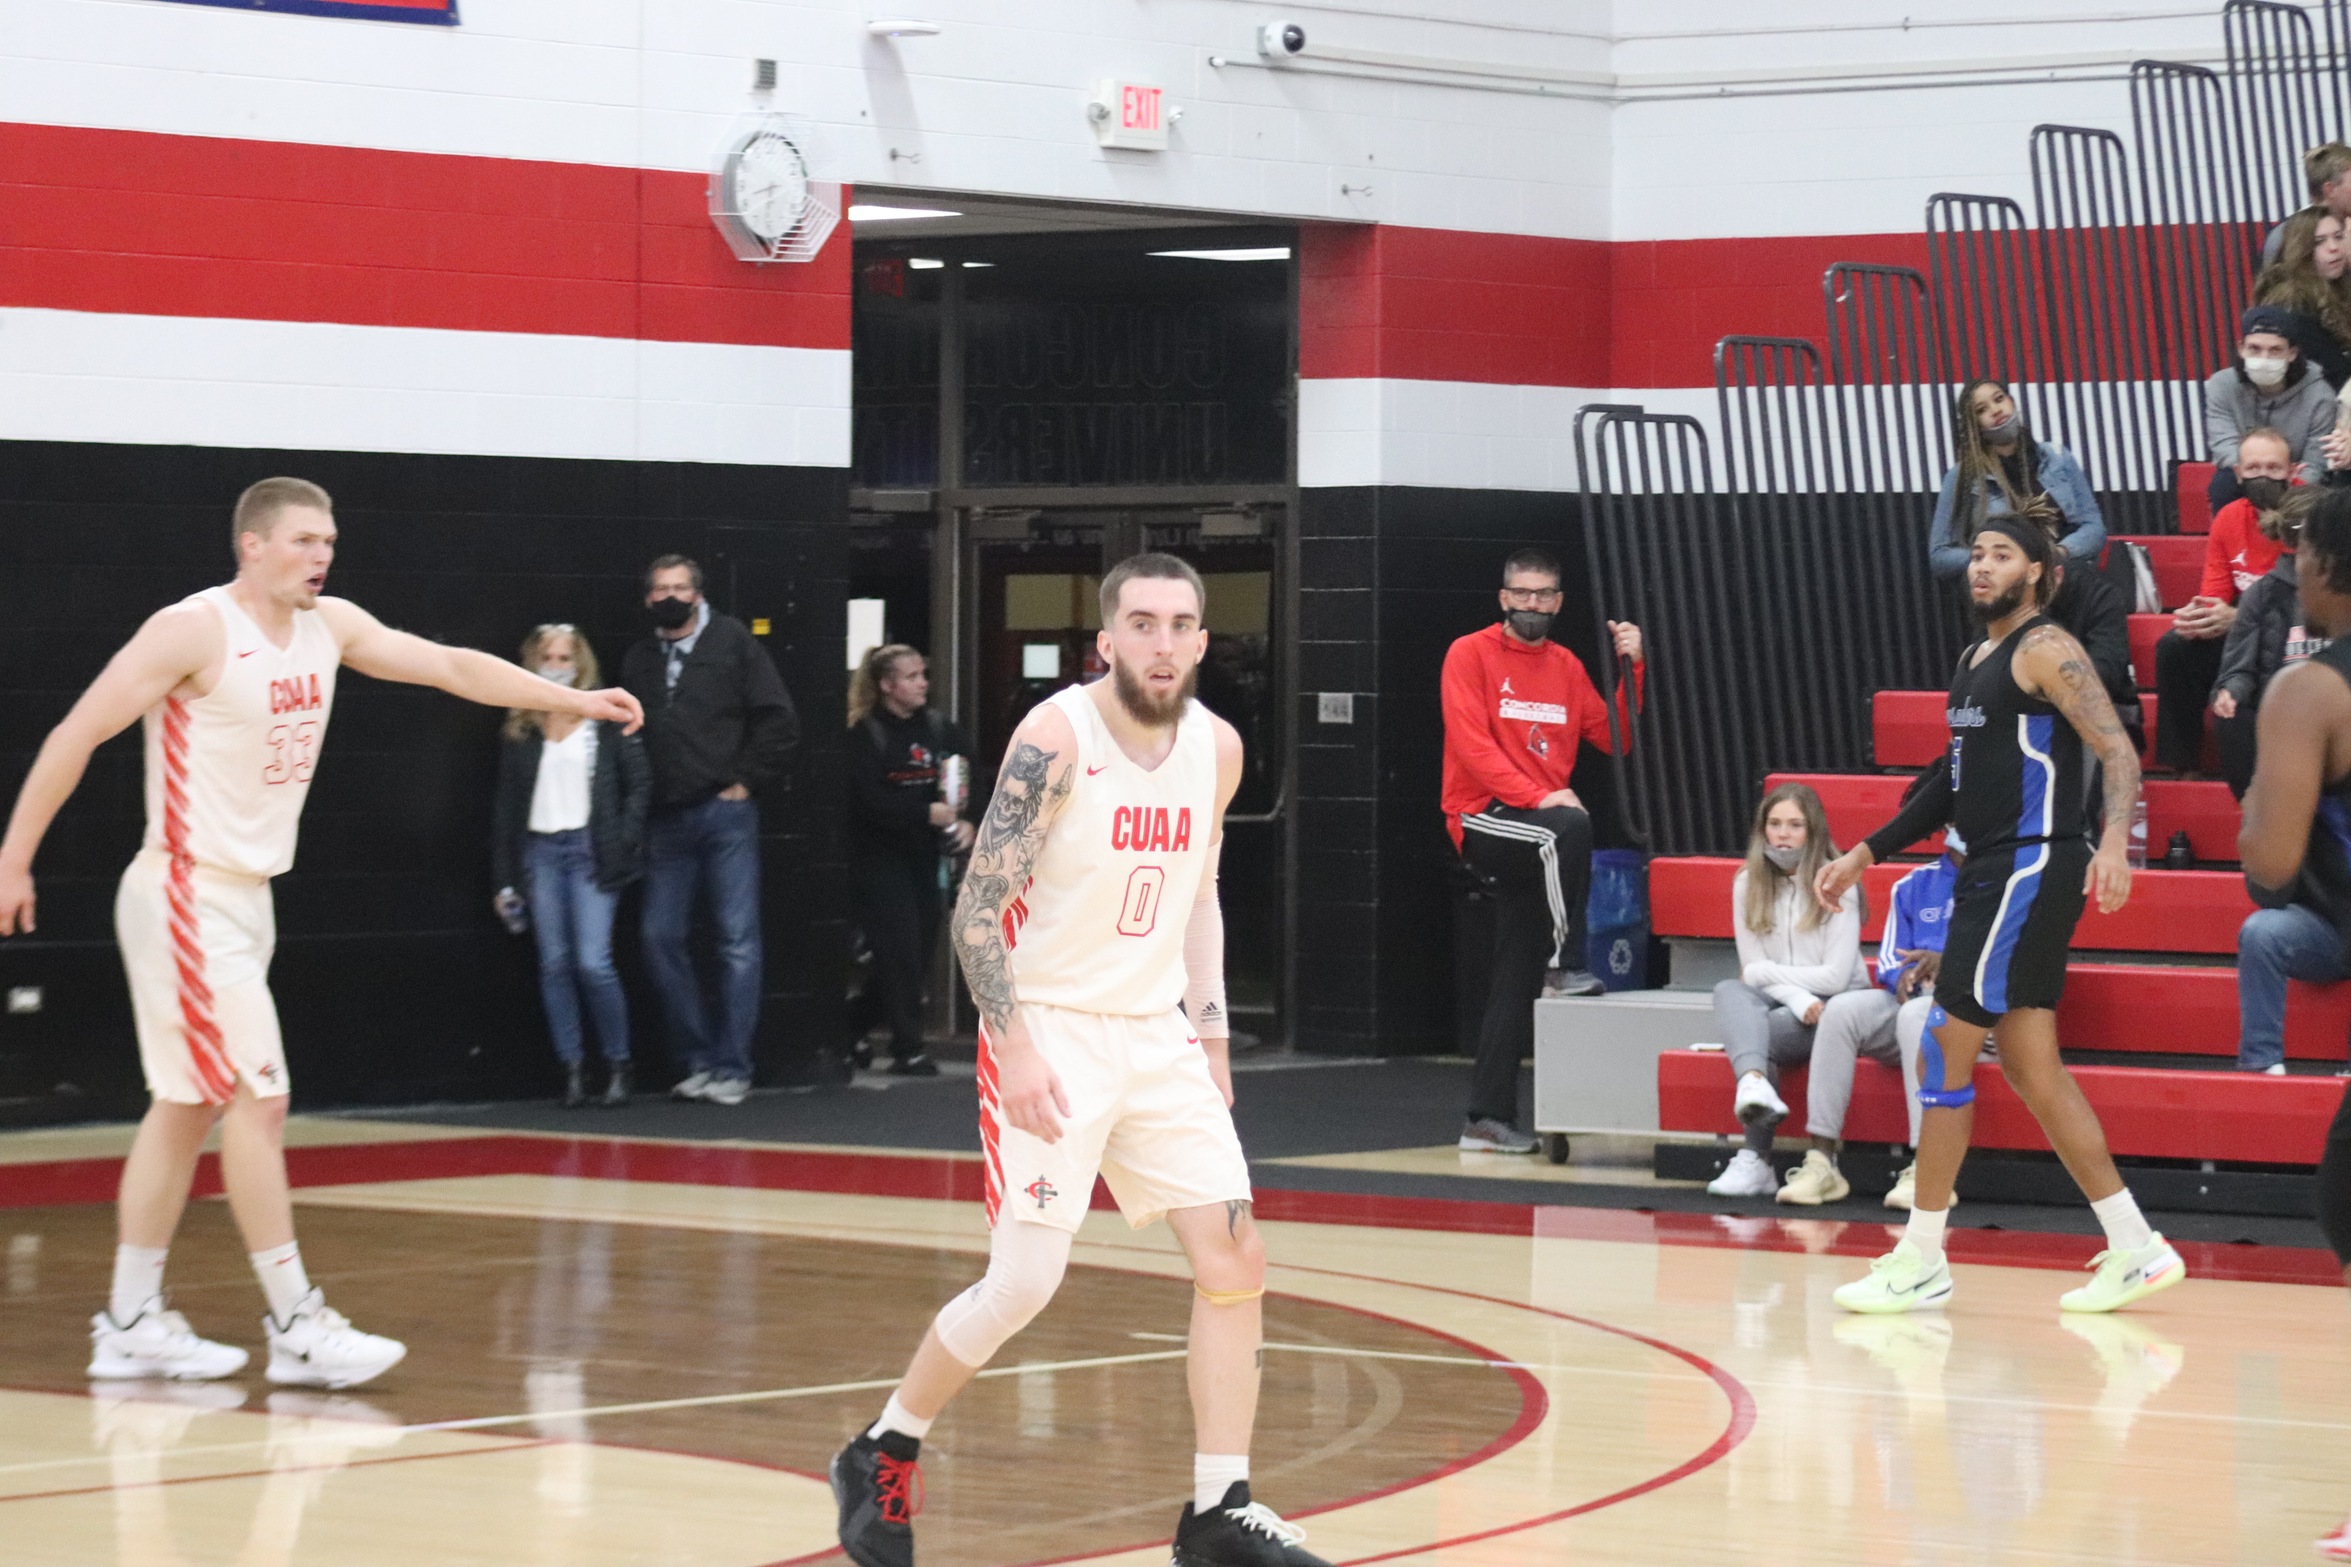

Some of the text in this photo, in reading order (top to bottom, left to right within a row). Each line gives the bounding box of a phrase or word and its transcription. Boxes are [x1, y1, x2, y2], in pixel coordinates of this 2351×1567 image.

[1122, 86, 1162, 130] EXIT
[261, 720, 321, 785] 33
[1111, 805, 1191, 852] CUAA
[1116, 865, 1165, 938] 0
